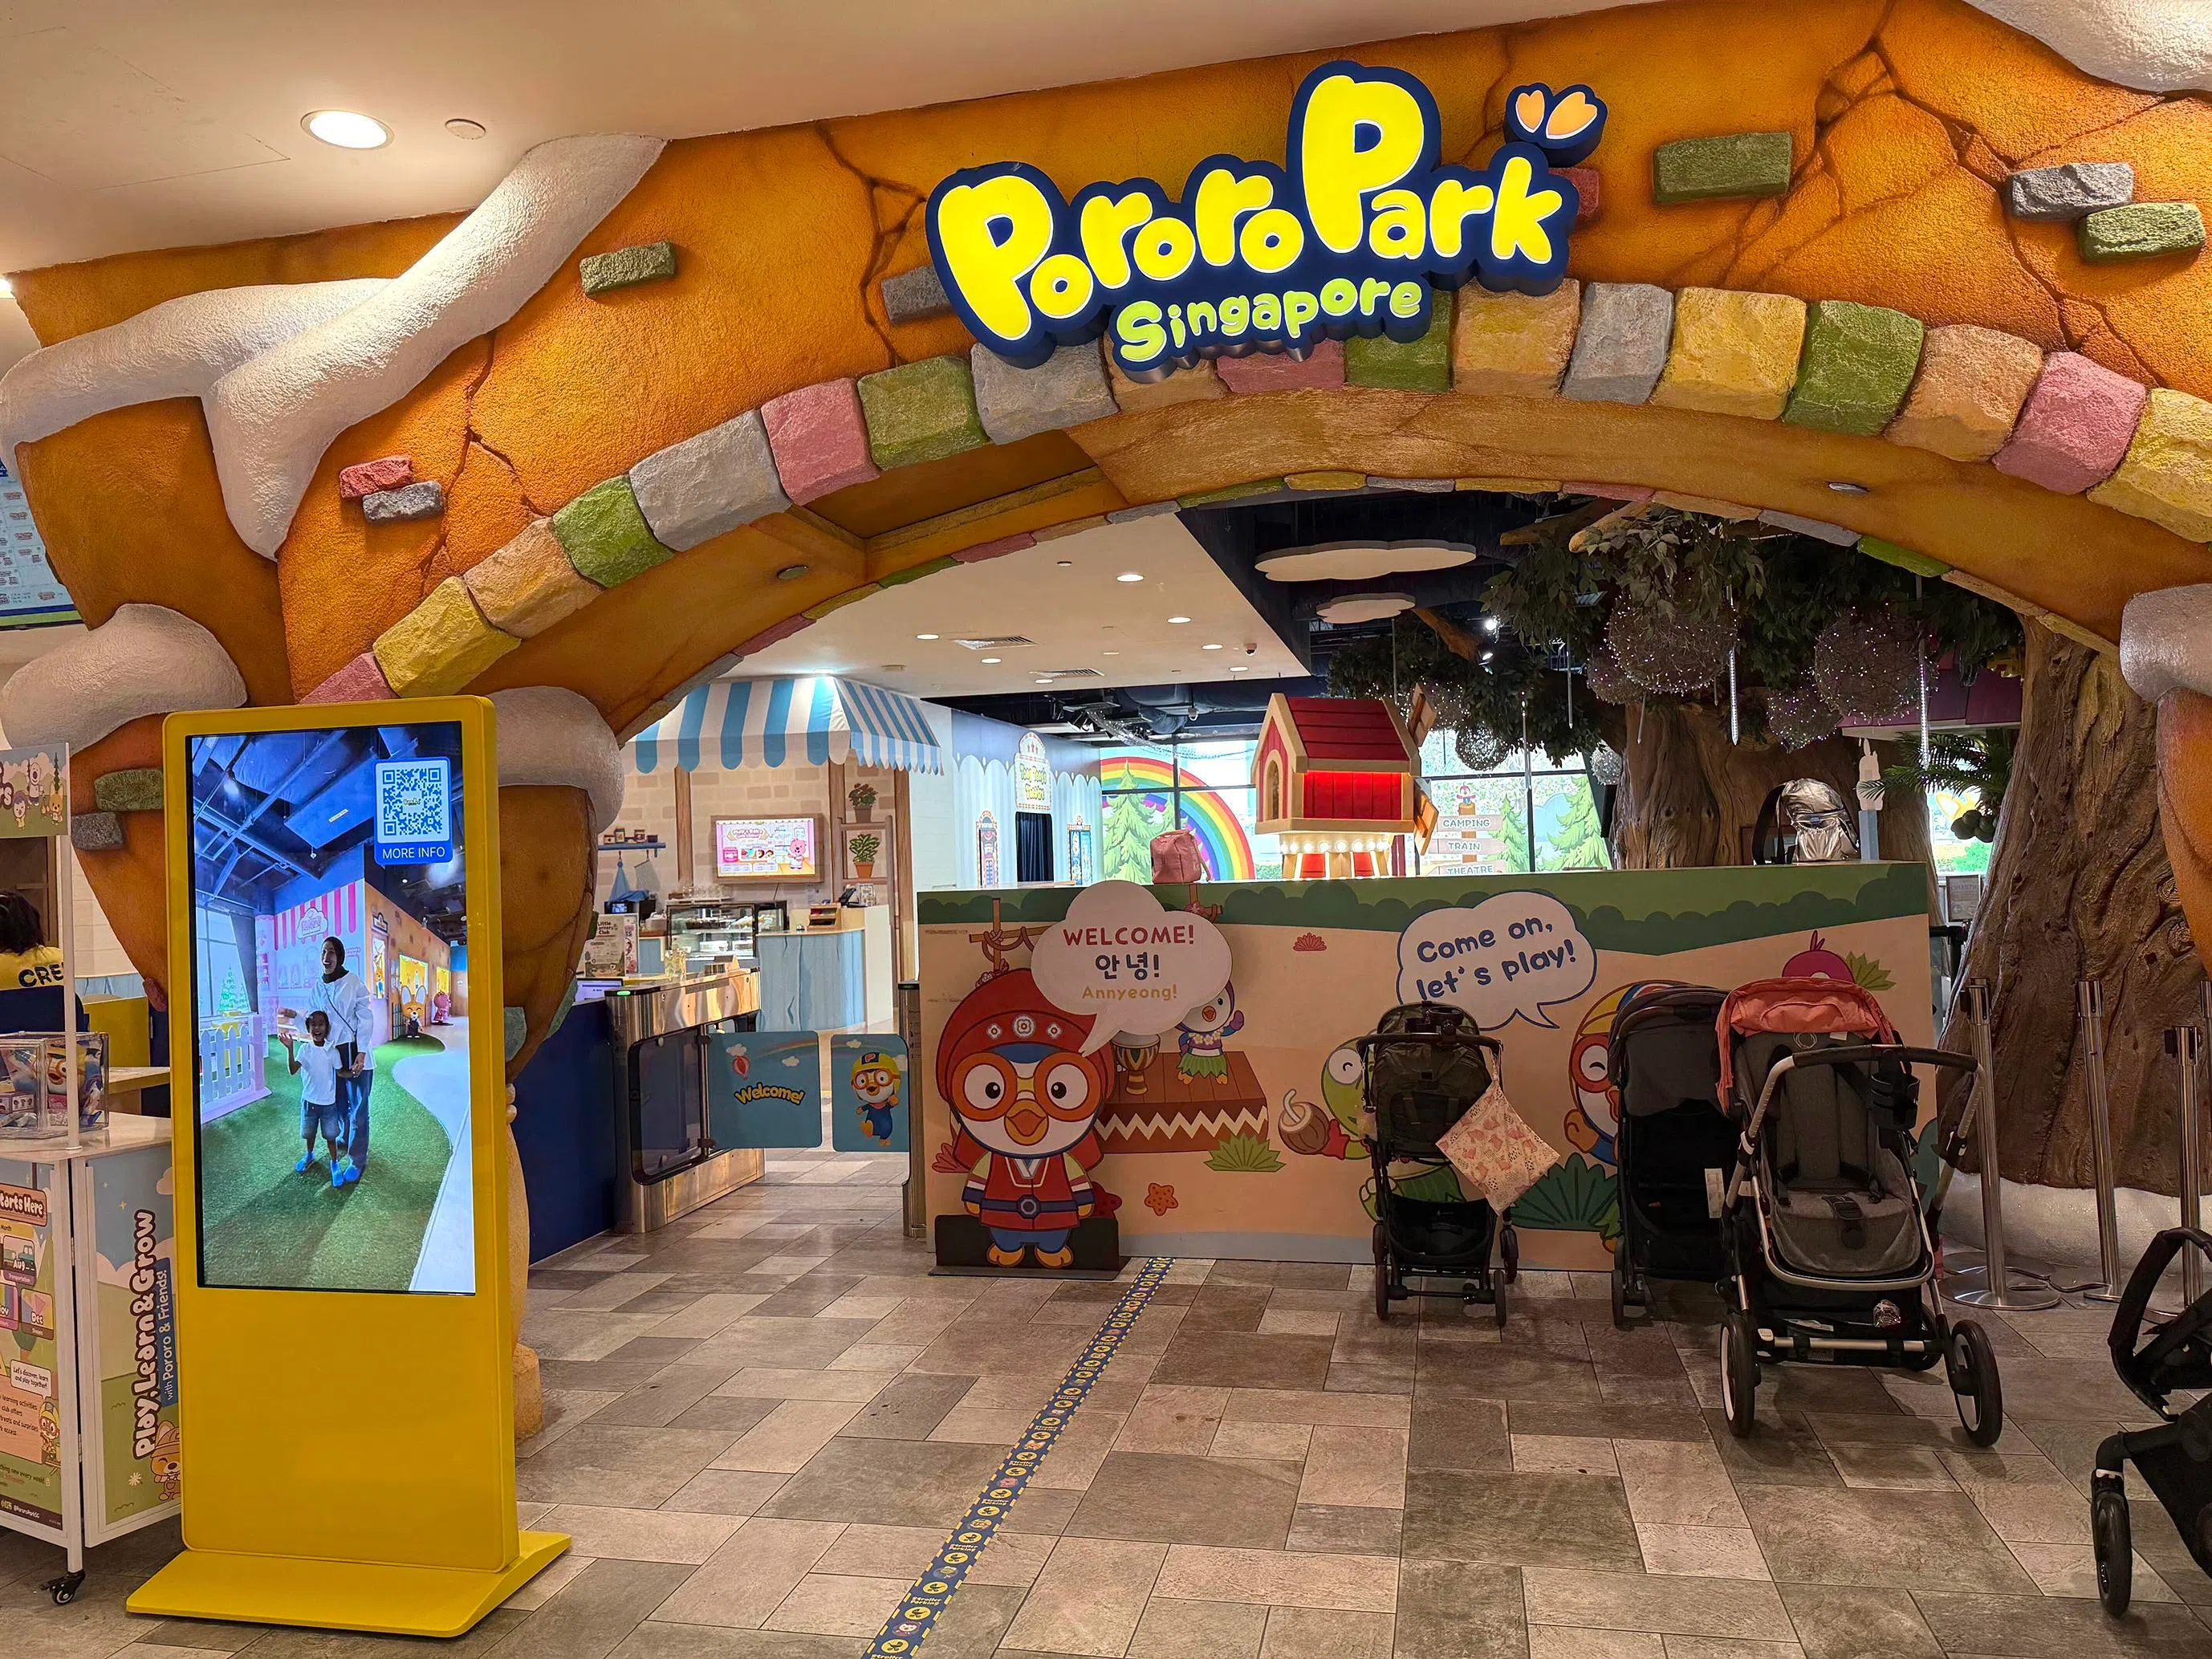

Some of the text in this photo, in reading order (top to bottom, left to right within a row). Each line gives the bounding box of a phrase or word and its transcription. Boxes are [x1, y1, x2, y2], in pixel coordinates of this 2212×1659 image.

[937, 74, 1562, 340] Pororo Park
[1120, 276, 1422, 361] Singapore
[1443, 819, 1490, 827] CAMPING
[383, 846, 445, 859] MORE INFO
[1448, 842, 1481, 850] TRAIN
[1447, 865, 1494, 875] THEATRE
[1063, 925, 1194, 945] WELCOME!
[1417, 917, 1553, 963] Come on,
[18, 963, 64, 988] CRE
[1095, 952, 1160, 981] 안녕!
[1416, 939, 1576, 1001] let's play!
[1082, 984, 1178, 1001] Annyeong!
[734, 1082, 806, 1106] Welcome!
[0, 1192, 44, 1218] tarts Here
[131, 1210, 155, 1294] Grow
[31, 1311, 44, 1324] Dec
[157, 1270, 173, 1401] with Pororo & Friends!
[133, 1314, 157, 1393] Learn
[134, 1391, 160, 1459] Play,
